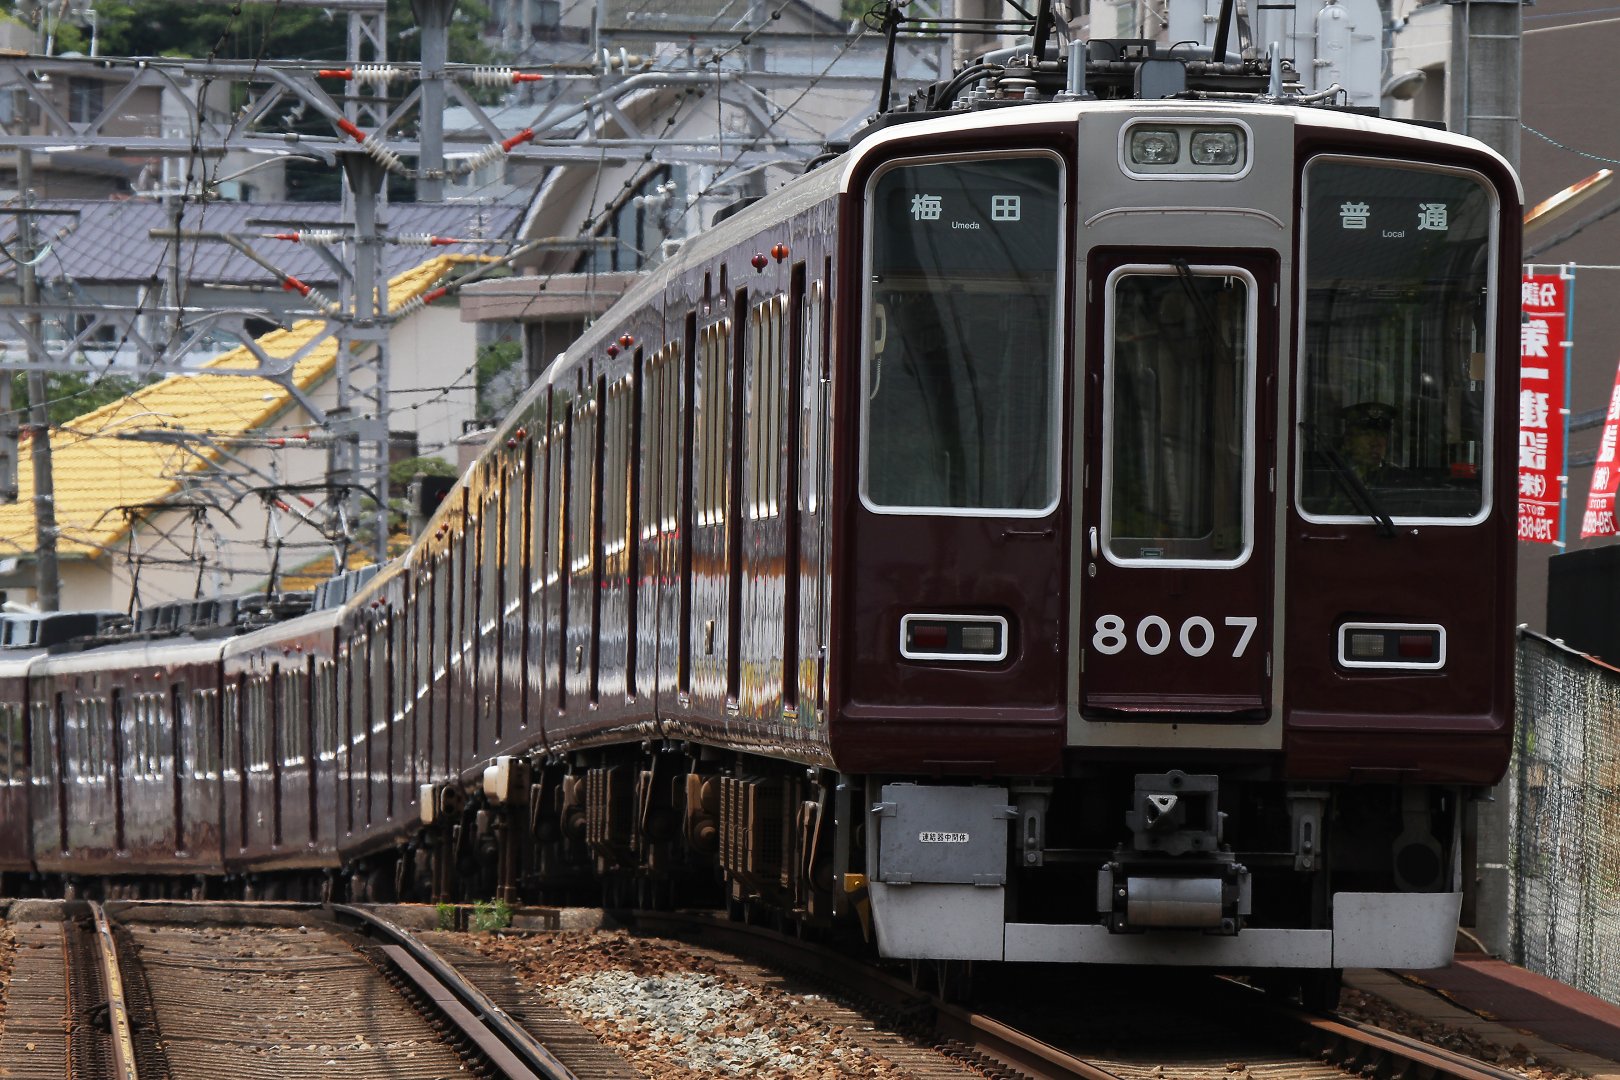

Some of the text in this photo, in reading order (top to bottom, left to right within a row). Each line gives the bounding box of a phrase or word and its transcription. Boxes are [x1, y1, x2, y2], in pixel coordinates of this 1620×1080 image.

[951, 221, 980, 230] Umeda
[1382, 229, 1405, 238] Local
[1092, 614, 1258, 658] 8007
